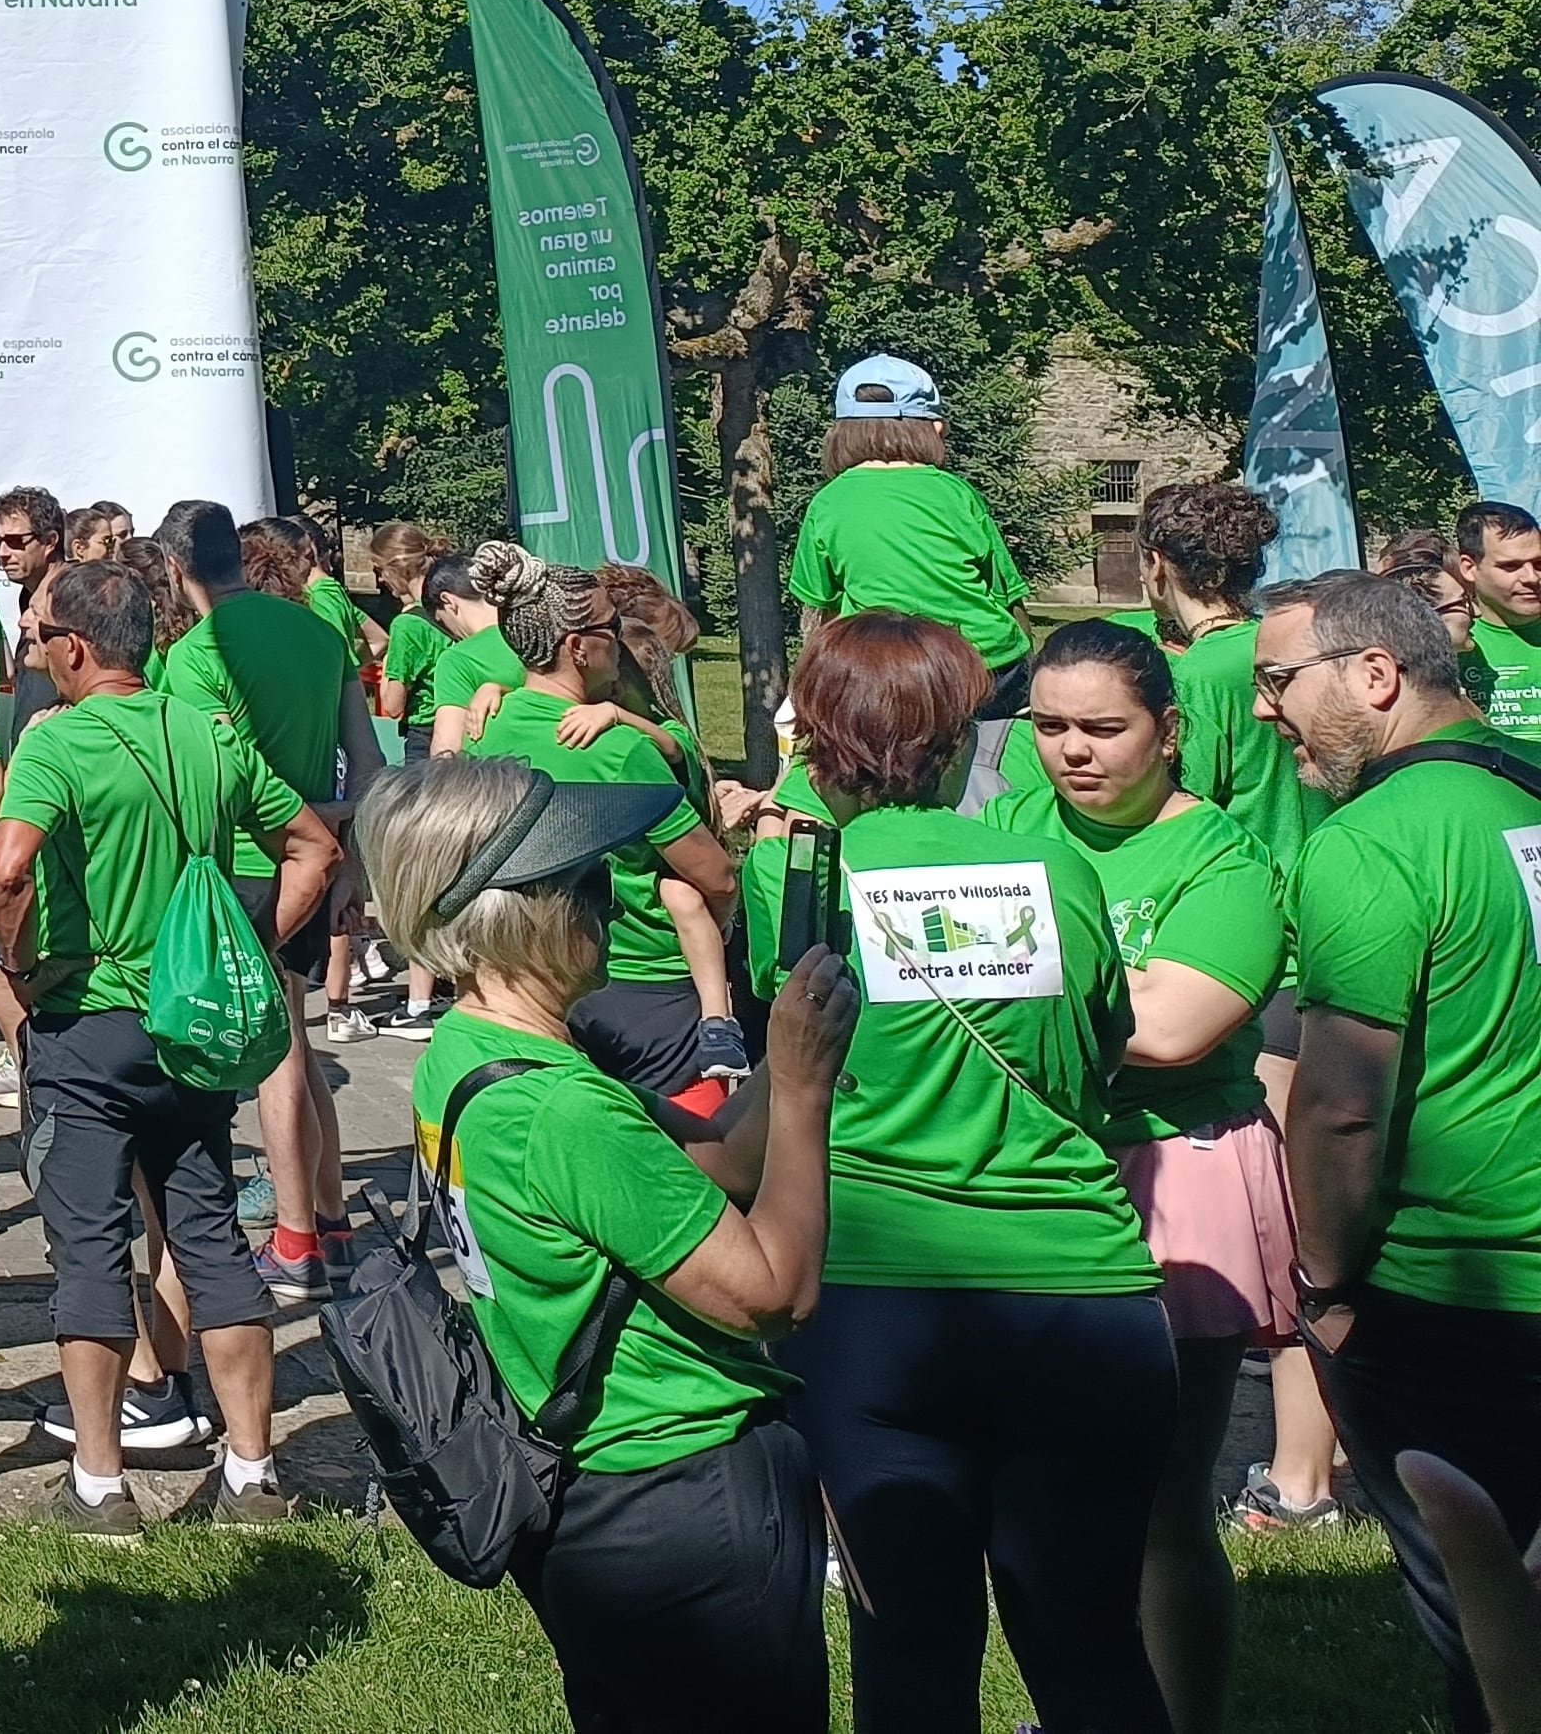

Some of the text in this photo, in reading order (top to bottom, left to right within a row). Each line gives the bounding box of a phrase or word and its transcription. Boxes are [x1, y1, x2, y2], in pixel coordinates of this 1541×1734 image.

[161, 123, 231, 136] asociación
[161, 138, 219, 151] contra el
[162, 154, 234, 166] en Navarra
[3, 336, 63, 353] española
[170, 334, 240, 346] asociación
[170, 349, 229, 362] contra el
[171, 366, 244, 377] en Navarra
[893, 888, 956, 903] Navarro
[959, 883, 1031, 899] Villoslada
[958, 964, 974, 977] el
[978, 960, 1034, 976] cáncer
